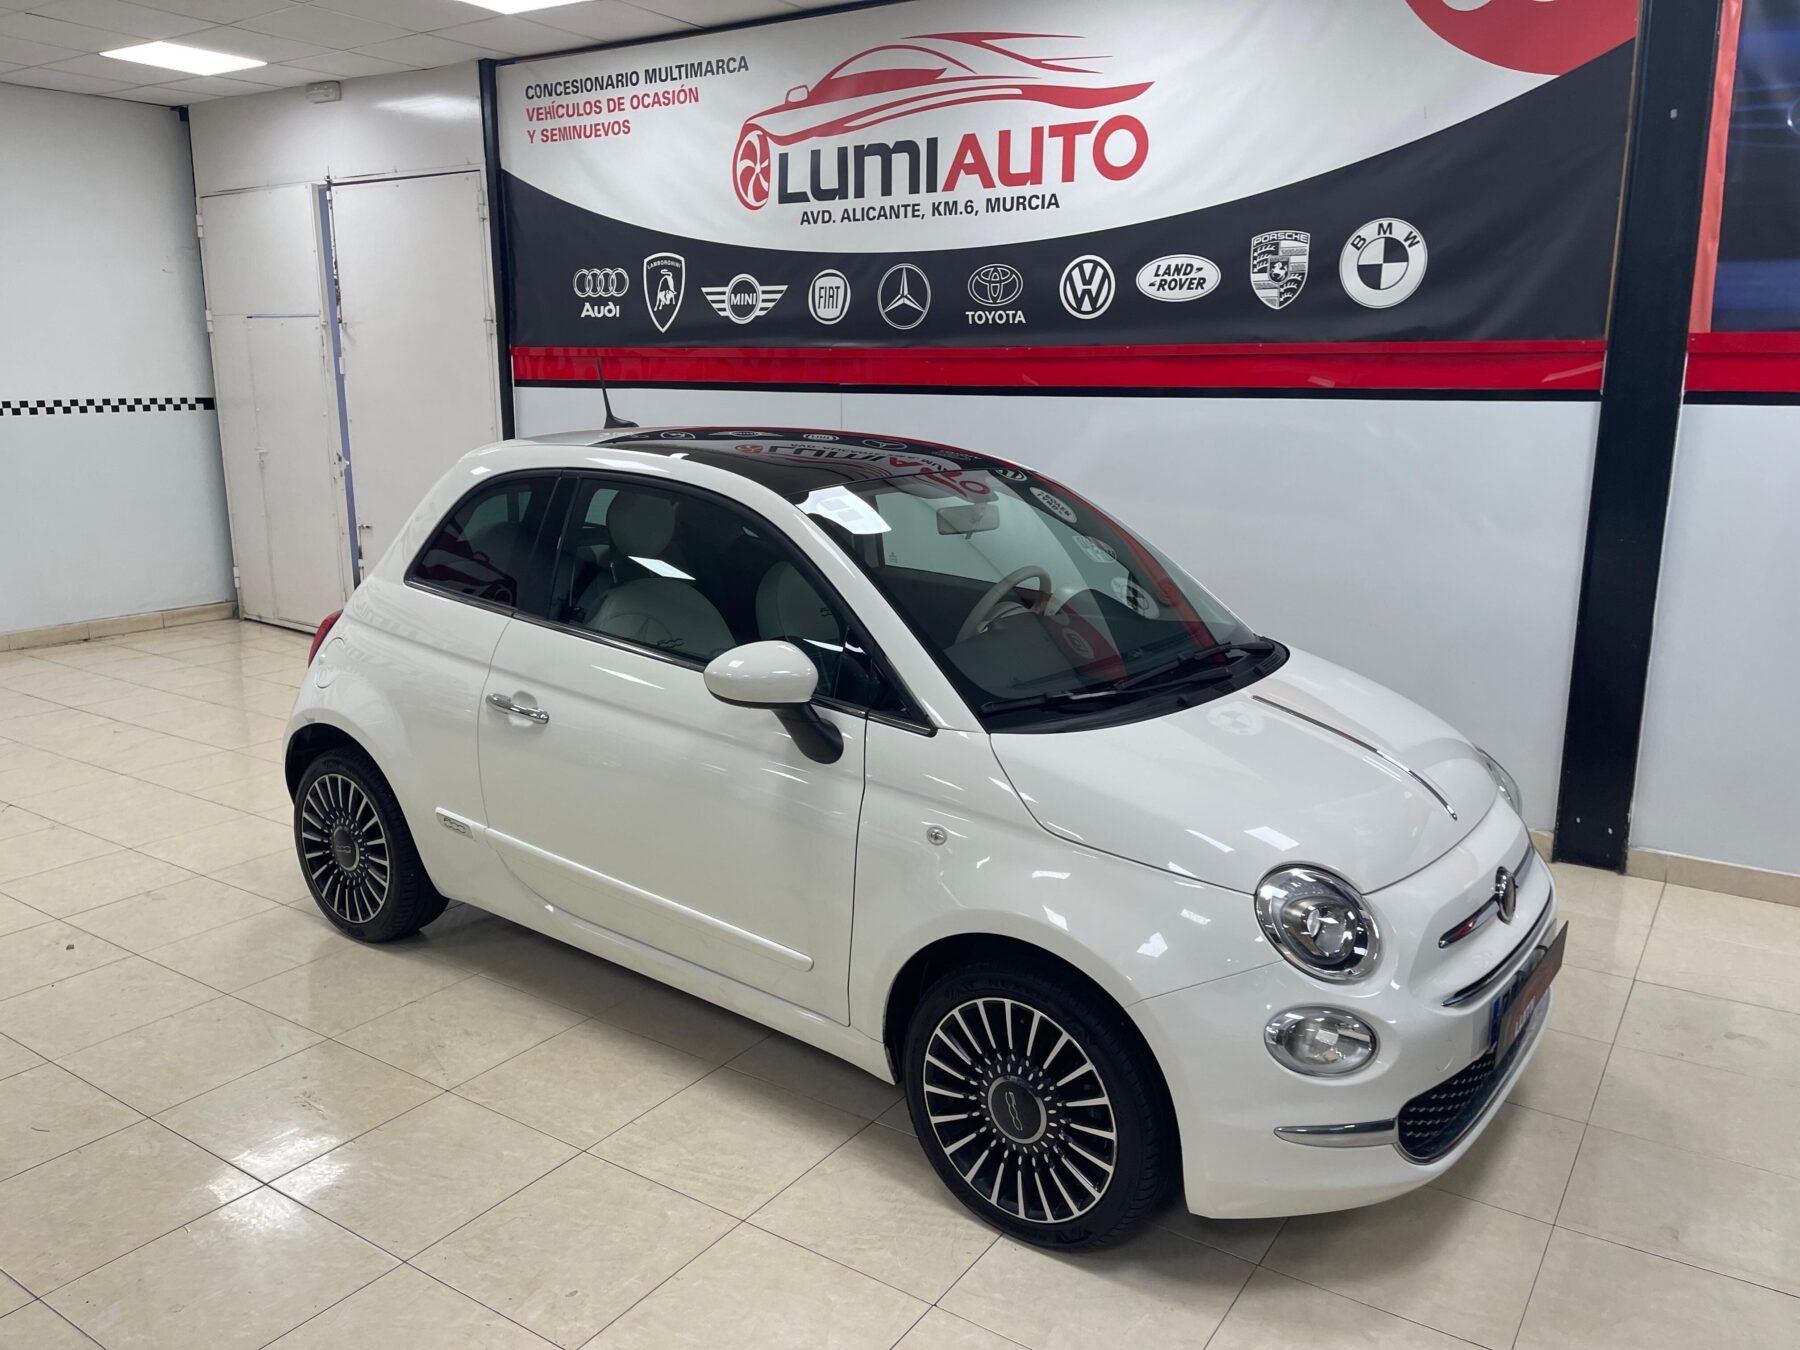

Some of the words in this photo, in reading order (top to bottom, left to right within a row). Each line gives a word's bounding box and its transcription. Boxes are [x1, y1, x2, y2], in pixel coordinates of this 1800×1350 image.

[525, 71, 640, 100] CONCESIONARIO
[644, 55, 749, 85] MULTIMARCA
[526, 99, 602, 122] VEHÍCULOS
[606, 96, 625, 113] DE
[630, 84, 699, 110] OCASIÓN
[527, 130, 536, 144] Y
[540, 119, 631, 143] SEMINUEVOS
[777, 114, 1149, 205] LUMIAUTO
[799, 211, 836, 226] AVD.
[841, 203, 926, 223] ALICANTE,
[931, 199, 979, 217] KM.6,
[985, 193, 1060, 214] MURCIA
[1253, 232, 1308, 246] PORSCHE
[1350, 222, 1420, 252] BMW
[1154, 263, 1194, 278] LAND
[1156, 276, 1207, 292] ROVER
[580, 302, 620, 318] Audi
[730, 293, 757, 306] MINI
[818, 285, 841, 310] FIAT
[966, 310, 1026, 325] TOYOTA
